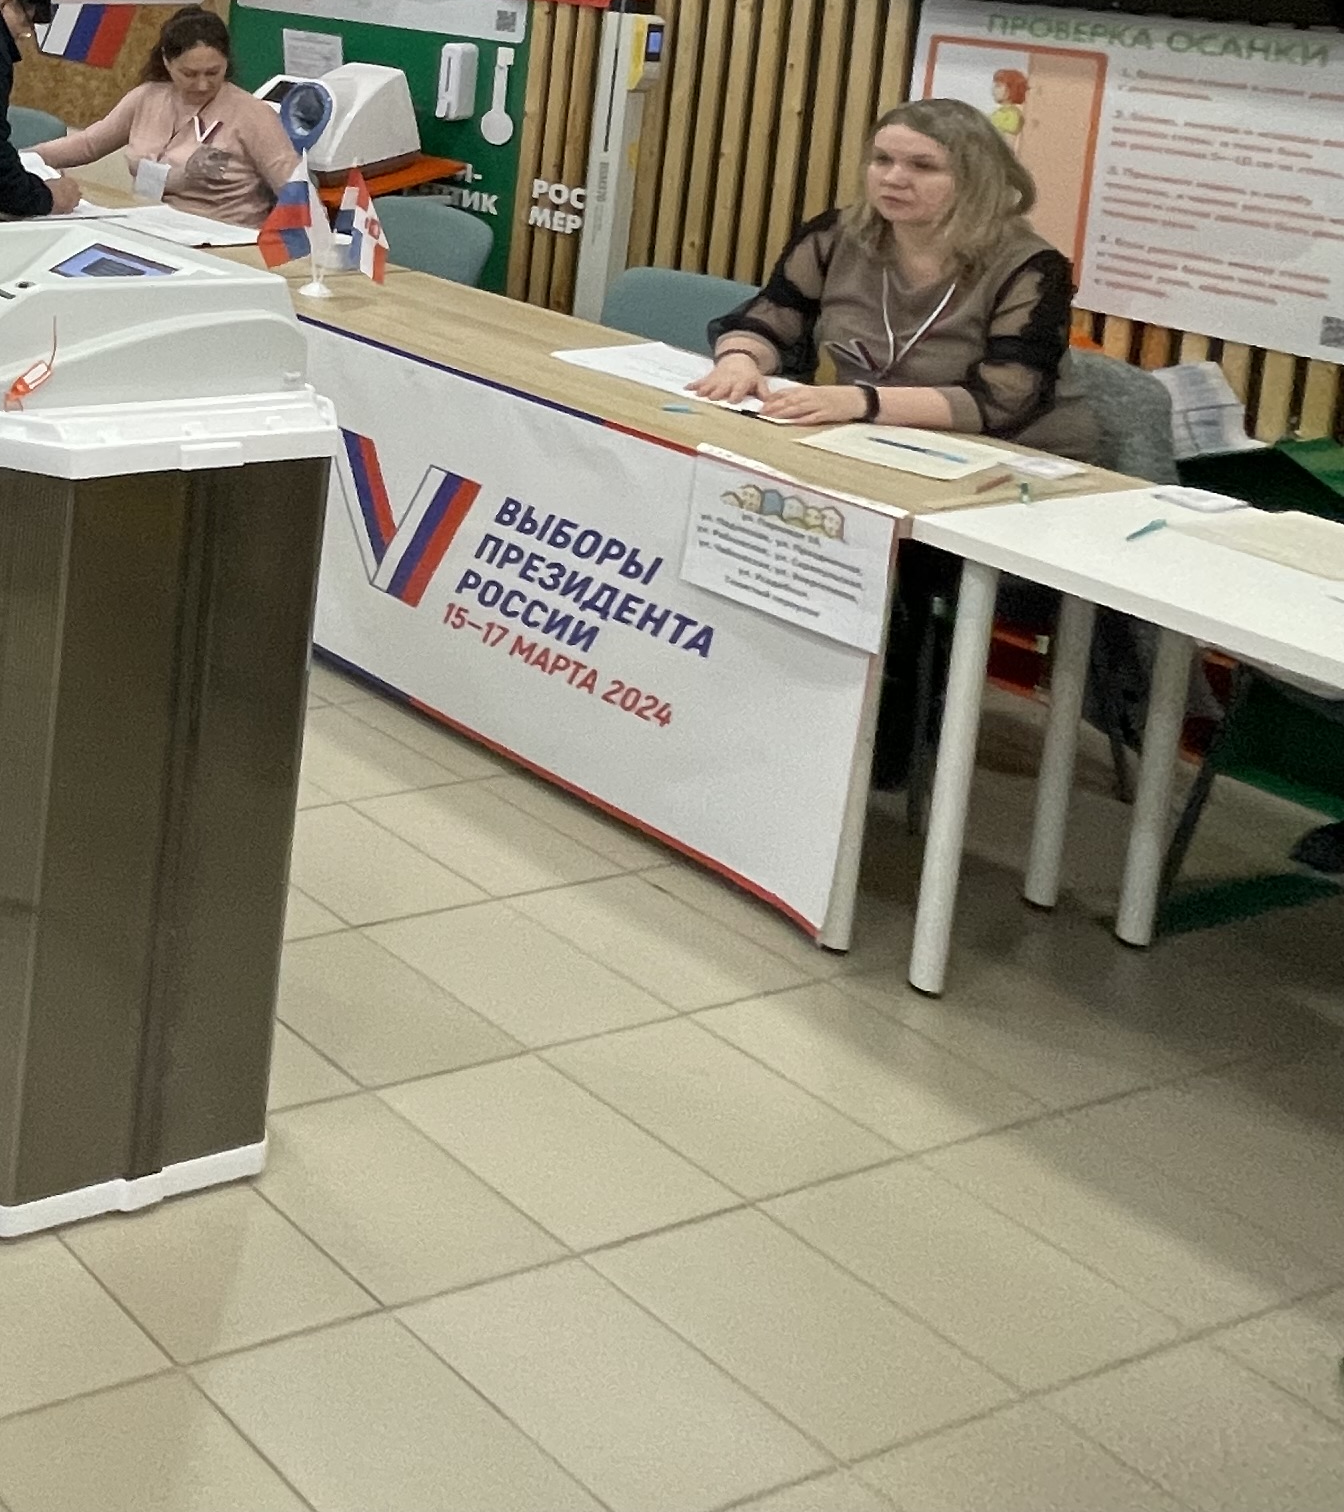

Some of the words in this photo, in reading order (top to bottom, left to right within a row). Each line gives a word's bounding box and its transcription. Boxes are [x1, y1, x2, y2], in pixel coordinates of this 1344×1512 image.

[985, 13, 1155, 50] ПРОВЕРКА
[1165, 31, 1330, 67] ОСАНКИ
[528, 206, 582, 235] МЕР
[494, 496, 664, 586] ВЫБОРЫ
[454, 568, 600, 653] РОССИИ
[473, 532, 715, 659] ПРЕЗИДЕНТА
[508, 634, 599, 695] МАРТА
[600, 679, 673, 728] 2024
